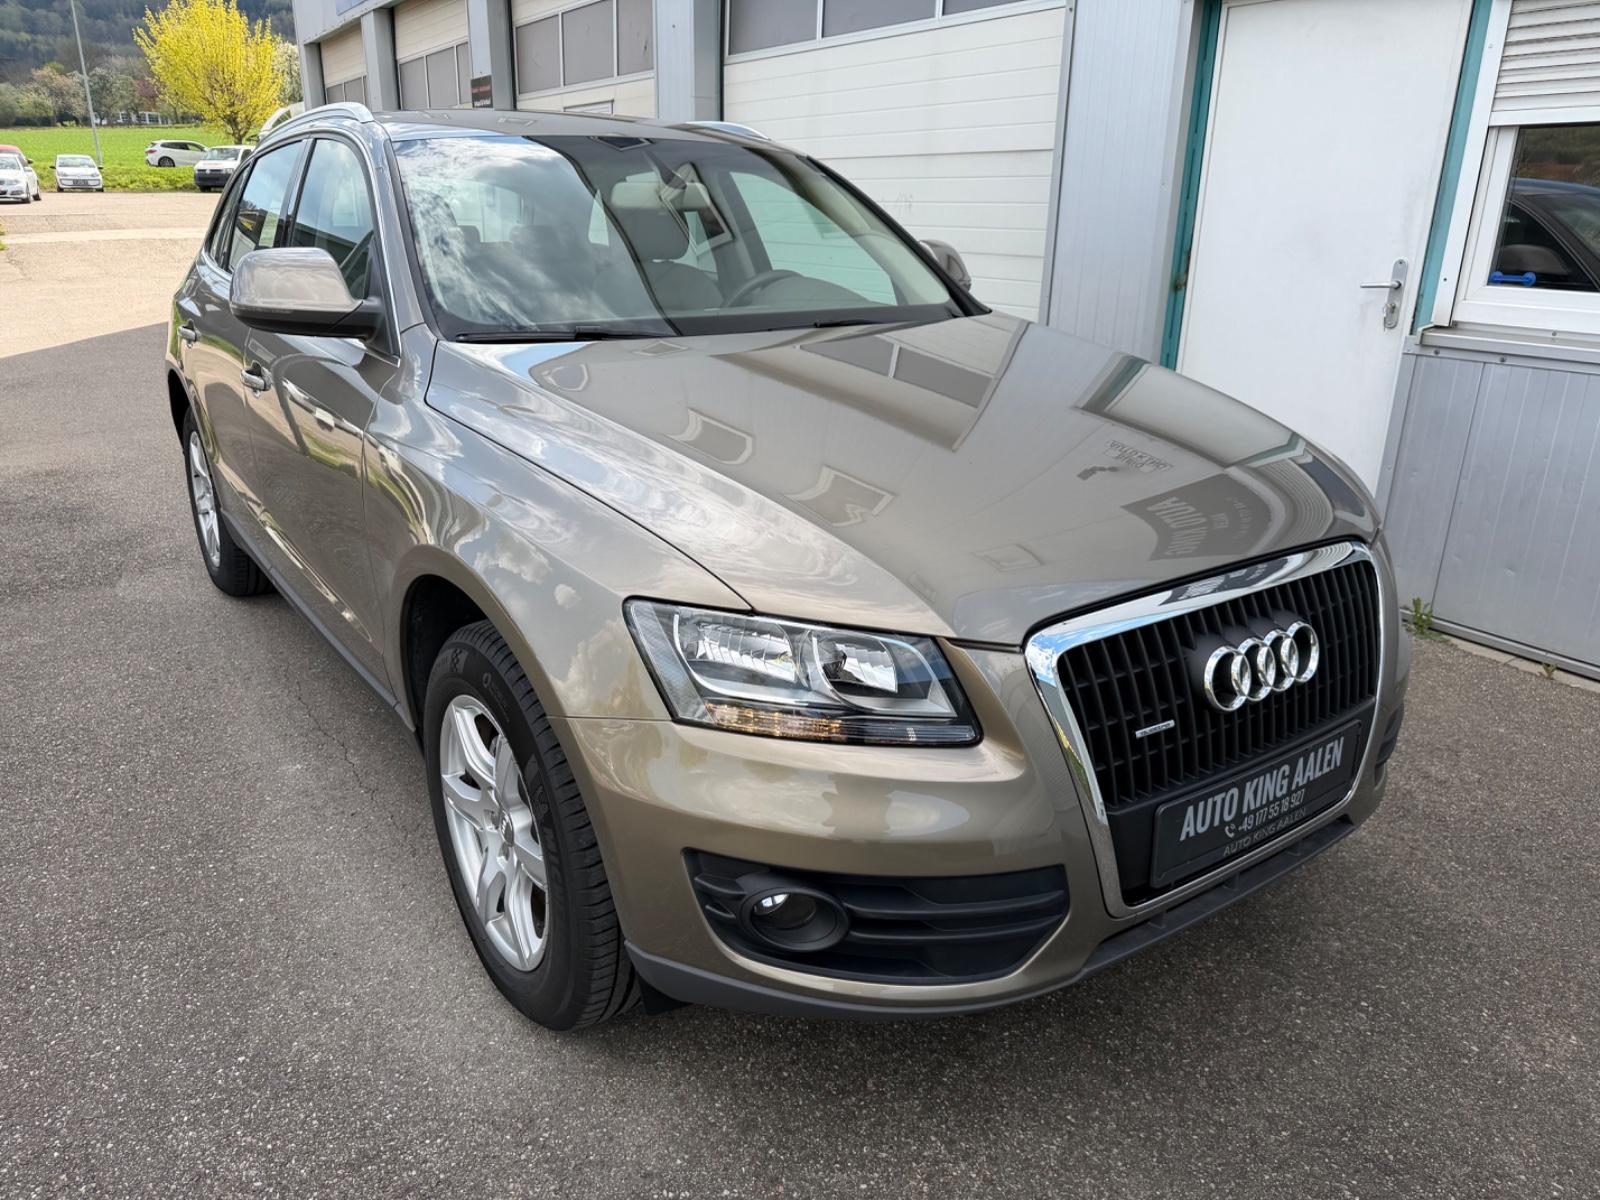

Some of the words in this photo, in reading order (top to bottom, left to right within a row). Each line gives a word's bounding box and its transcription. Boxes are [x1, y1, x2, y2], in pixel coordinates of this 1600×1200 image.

[1179, 787, 1239, 842] AUTO
[1242, 764, 1290, 814] KING
[1291, 736, 1344, 791] AALEN
[1223, 836, 1252, 857] AUTO
[1253, 826, 1276, 843] KING
[1276, 808, 1307, 831] AALEN
